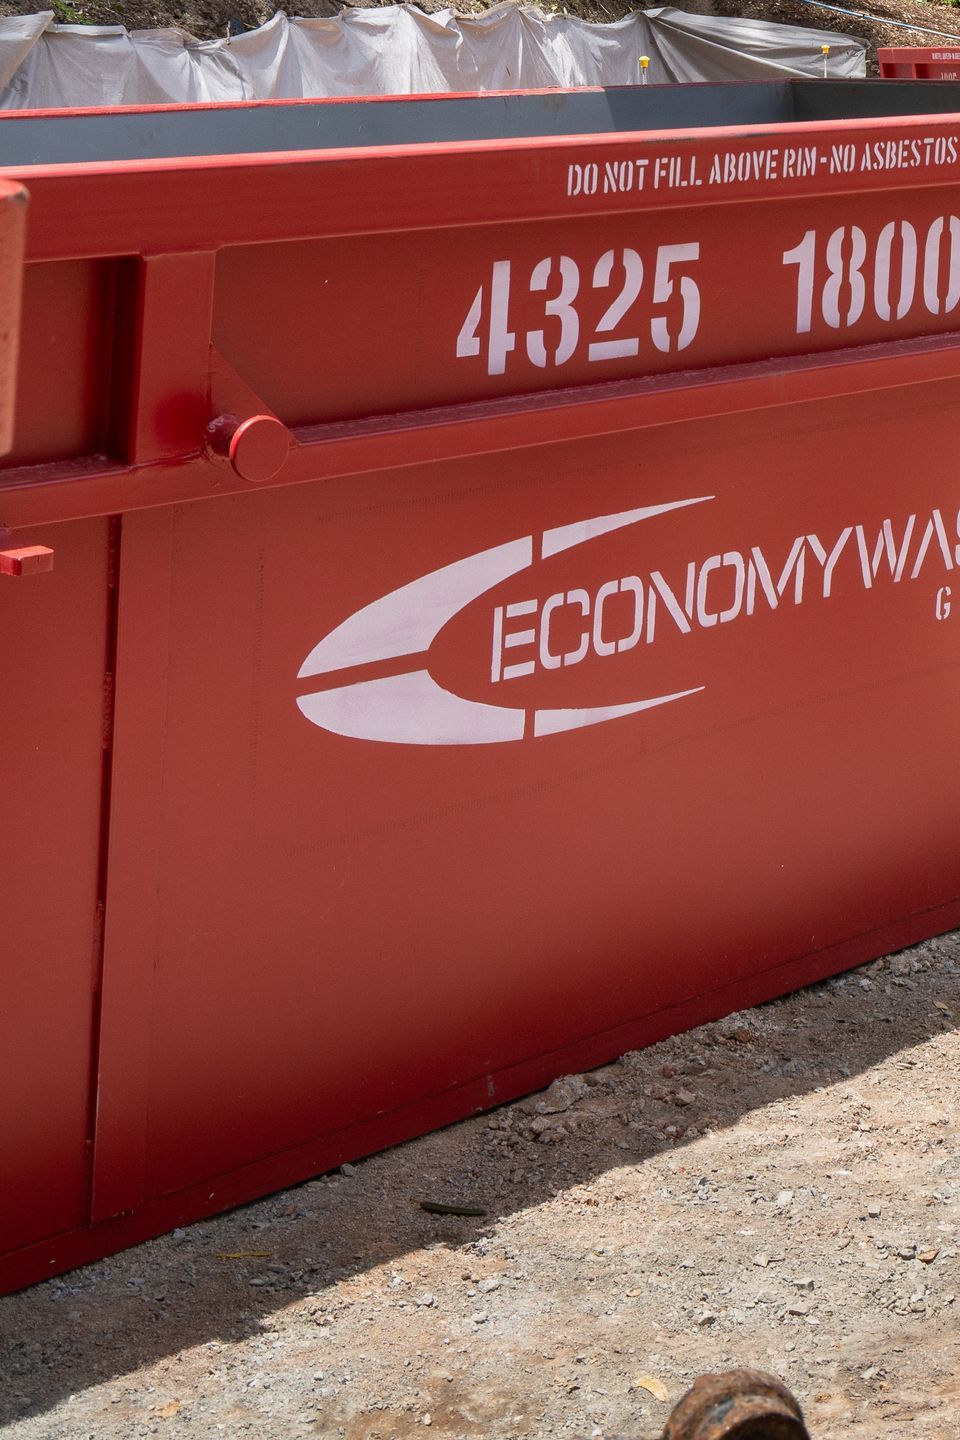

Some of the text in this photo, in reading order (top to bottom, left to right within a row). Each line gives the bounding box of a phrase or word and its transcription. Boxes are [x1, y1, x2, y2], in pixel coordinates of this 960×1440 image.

[567, 163, 599, 196] DO
[603, 159, 649, 194] NOT
[654, 156, 703, 190] FILL
[708, 149, 780, 186] ABOVE
[860, 136, 958, 171] ASBESTOS
[456, 242, 701, 375] 4325
